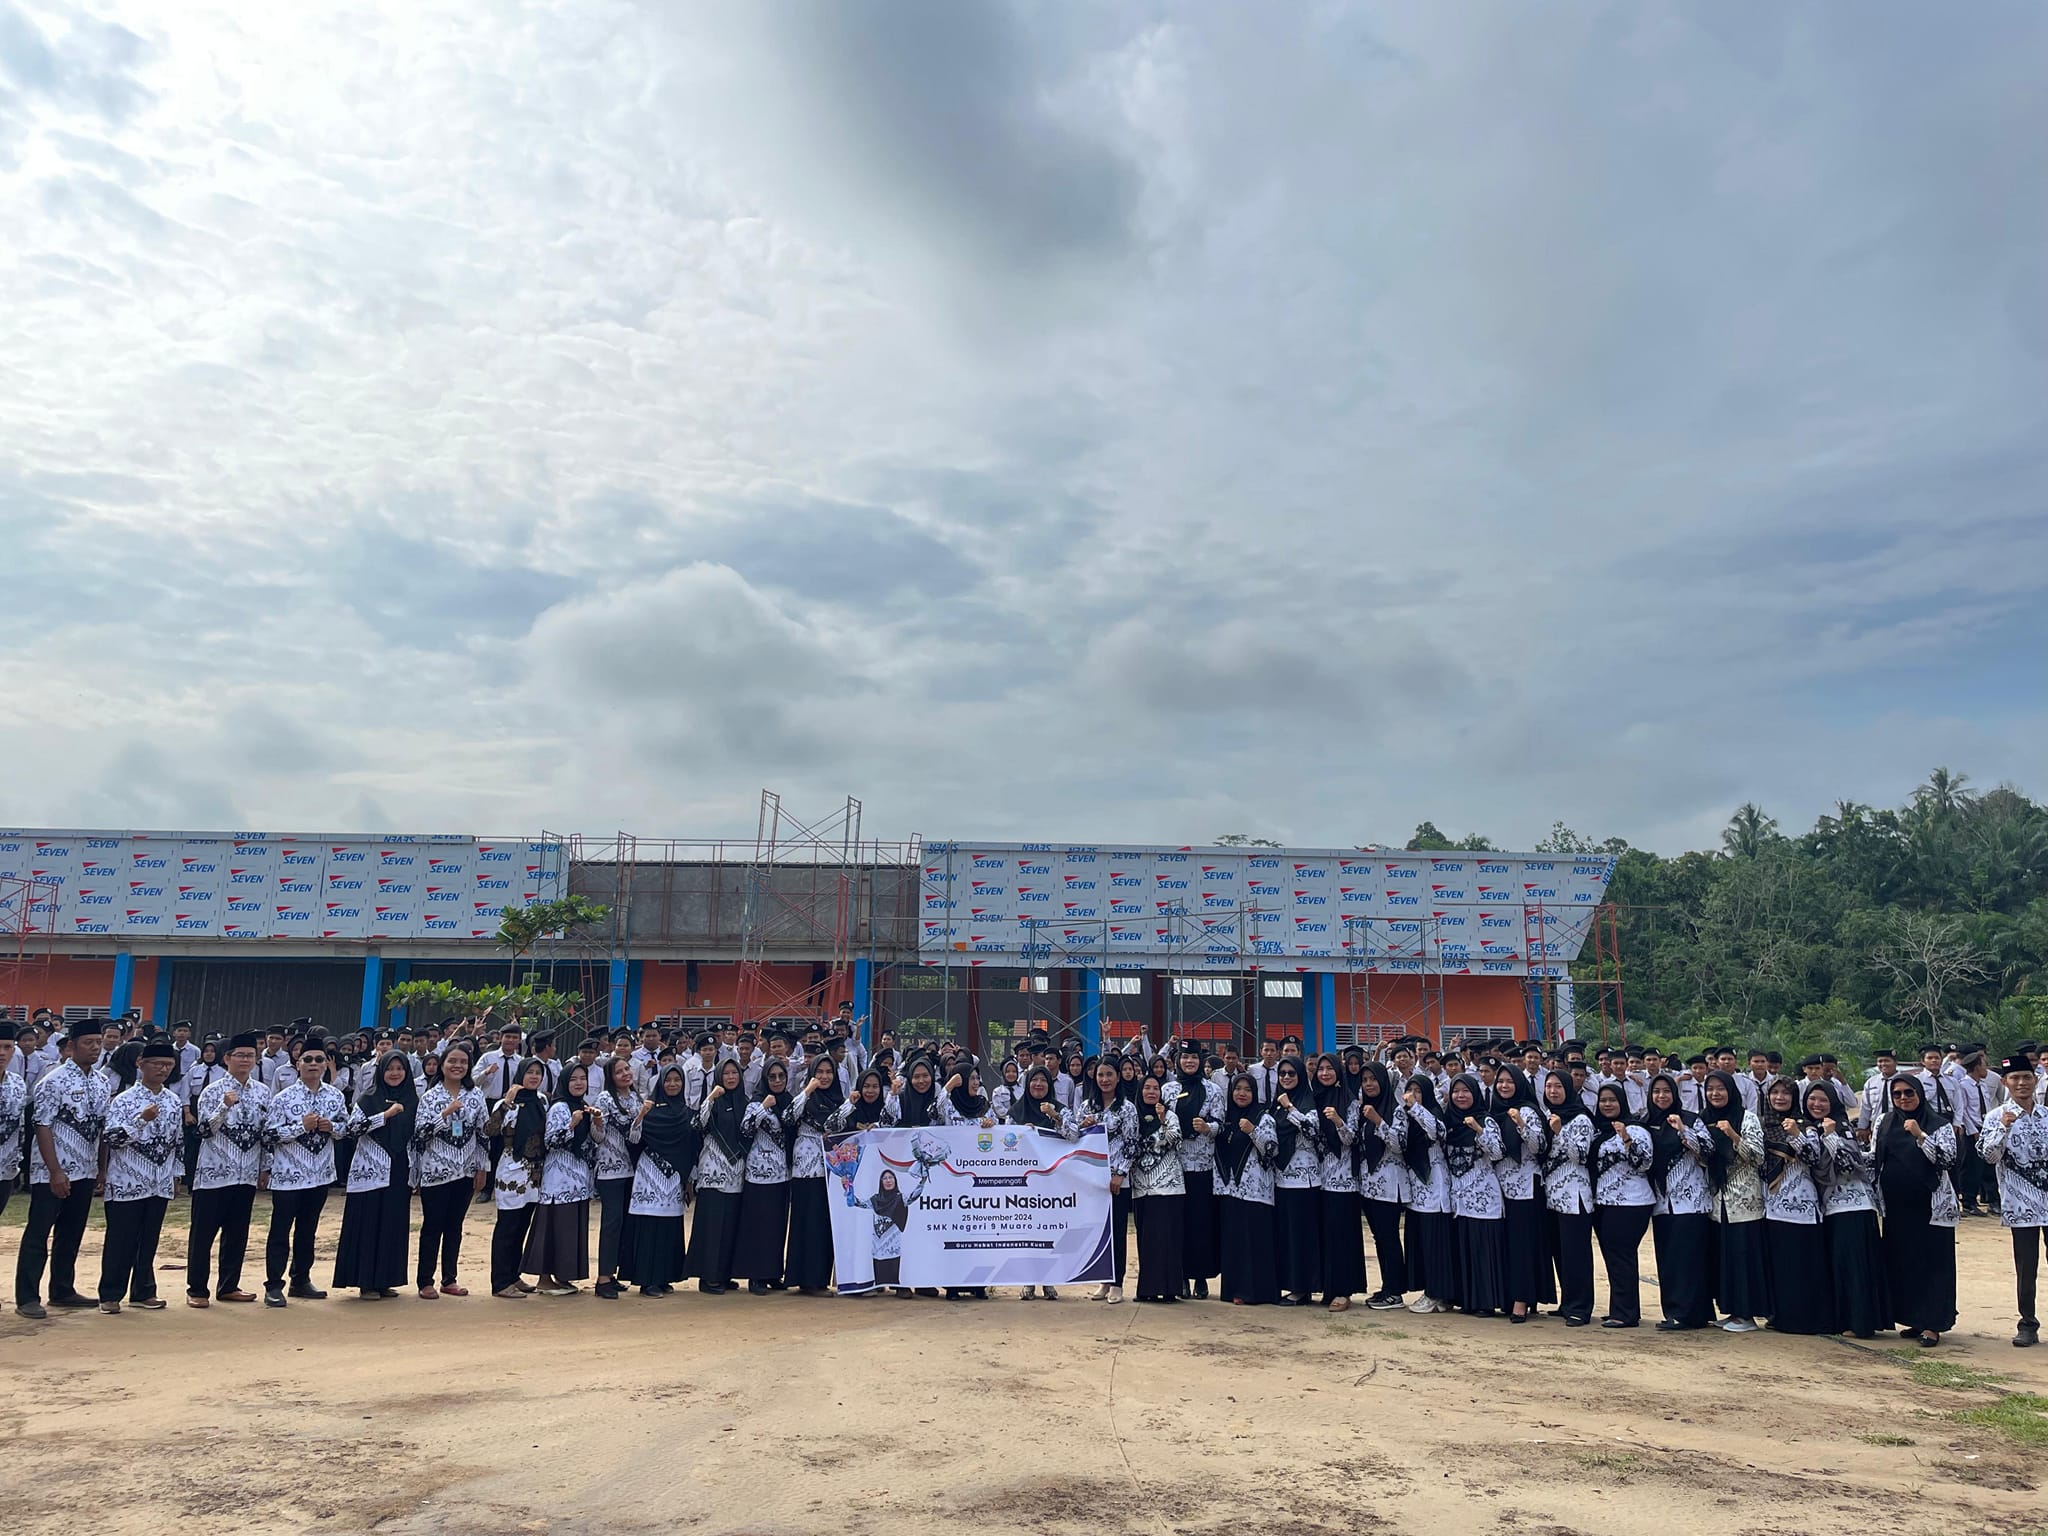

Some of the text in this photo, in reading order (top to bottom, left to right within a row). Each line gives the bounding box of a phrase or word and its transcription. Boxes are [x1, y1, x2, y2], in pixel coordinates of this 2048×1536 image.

[87, 840, 119, 848] SEVEN
[36, 848, 69, 856] SEVEN
[234, 847, 267, 855] SEVEN
[283, 856, 316, 864] SEVEN
[382, 857, 414, 865] SEVEN
[480, 853, 512, 861] SEVEN
[1066, 855, 1096, 863] SEVEN
[134, 860, 166, 868] SEVEN
[183, 864, 215, 872] SEVEN
[974, 860, 1004, 868] SEVEN
[1249, 860, 1279, 868] SEVEN
[1433, 864, 1463, 872] SEVEN
[1525, 863, 1554, 871] SEVEN
[83, 868, 116, 876] SEVEN
[430, 865, 462, 873] SEVEN
[1479, 865, 1509, 873] SEVEN
[1602, 857, 1617, 886] SEVEN
[1204, 872, 1233, 880] SEVEN
[1296, 870, 1326, 878] SEVEN
[1387, 870, 1417, 878] SEVEN
[34, 876, 65, 884] SEVEN
[231, 875, 264, 883] SEVEN
[1112, 878, 1141, 886] SEVEN
[280, 884, 312, 892] SEVEN
[330, 881, 363, 889] SEVEN
[379, 885, 412, 893] SEVEN
[130, 888, 162, 896] SEVEN
[973, 887, 1003, 895] SEVEN
[1250, 887, 1280, 895] SEVEN
[1527, 889, 1556, 897] SEVEN
[80, 896, 112, 904] SEVEN
[179, 892, 212, 900] SEVEN
[427, 893, 460, 901] SEVEN
[1342, 893, 1372, 901] SEVEN
[1480, 892, 1510, 900] SEVEN
[1388, 897, 1418, 905] SEVEN
[30, 904, 62, 912] SEVEN
[228, 903, 261, 911] SEVEN
[277, 912, 310, 920] SEVEN
[328, 909, 360, 917] SEVEN
[475, 908, 505, 916] SEVE
[127, 916, 160, 924] SEVEN
[376, 913, 409, 921] SEVEN
[1251, 914, 1280, 922] SEVEN
[176, 920, 209, 928] SEVEN
[1439, 918, 1465, 926] EVEN
[1481, 919, 1511, 927] SEVEN
[76, 924, 109, 932] SEVEN
[926, 928, 957, 936] SEVN
[1205, 926, 1234, 934] SEVEN
[1297, 924, 1327, 932] SEVEN
[1389, 924, 1419, 932] SEVEN
[1065, 936, 1095, 944] SEVEN
[1066, 956, 1096, 964] SEVEN
[1205, 956, 1235, 964] SEVEN
[1390, 961, 1420, 969] SEVEN
[1483, 963, 1512, 971] SEVEN
[956, 1158, 1039, 1169] Upacara Bendera
[978, 1178, 1023, 1186] Memperingati
[919, 1192, 1077, 1210] Hari Guru Nasional
[961, 1214, 971, 1222] 25
[1014, 1213, 1032, 1221] 2024
[952, 1223, 987, 1232] Negeri
[1036, 1221, 1068, 1230] Jambi
